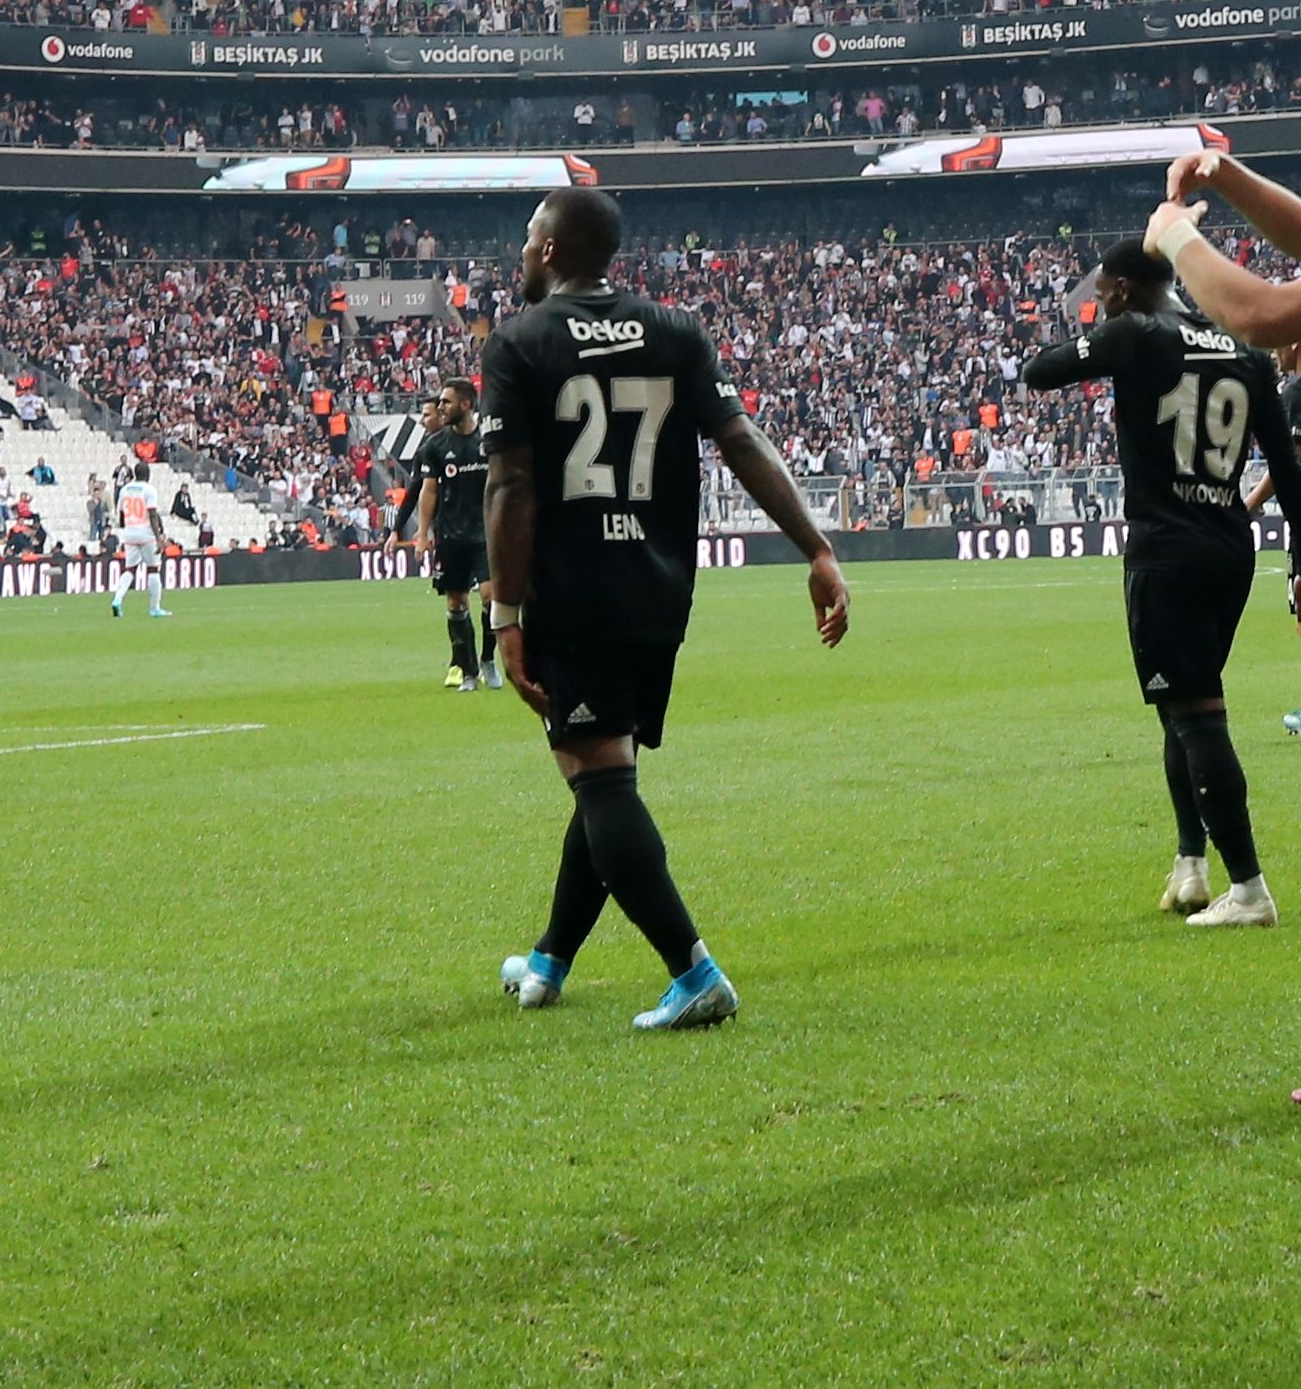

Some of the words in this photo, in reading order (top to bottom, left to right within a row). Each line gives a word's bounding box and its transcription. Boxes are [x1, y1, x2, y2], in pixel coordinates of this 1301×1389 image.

[1175, 4, 1264, 31] vodafone
[839, 33, 906, 53] vodafone
[983, 21, 1064, 46] BEŞİKTAŞ
[1064, 20, 1087, 39] JK
[67, 42, 133, 60] vodafone
[212, 45, 300, 67] BEŞİKTAŞ
[300, 47, 323, 65] JK
[419, 43, 514, 65] vodafone
[518, 44, 564, 66] park
[646, 39, 729, 64] BEŞİKTAŞ
[731, 40, 756, 59] JK
[350, 294, 369, 306] 119
[404, 293, 426, 306] 119
[566, 318, 644, 345] beko
[1179, 325, 1236, 352] beko
[555, 374, 675, 501] 27
[1157, 372, 1249, 481] 19
[957, 528, 1031, 560] XC90
[1050, 526, 1084, 557] B5
[360, 549, 408, 581] XC90
[2, 562, 51, 596] AWD
